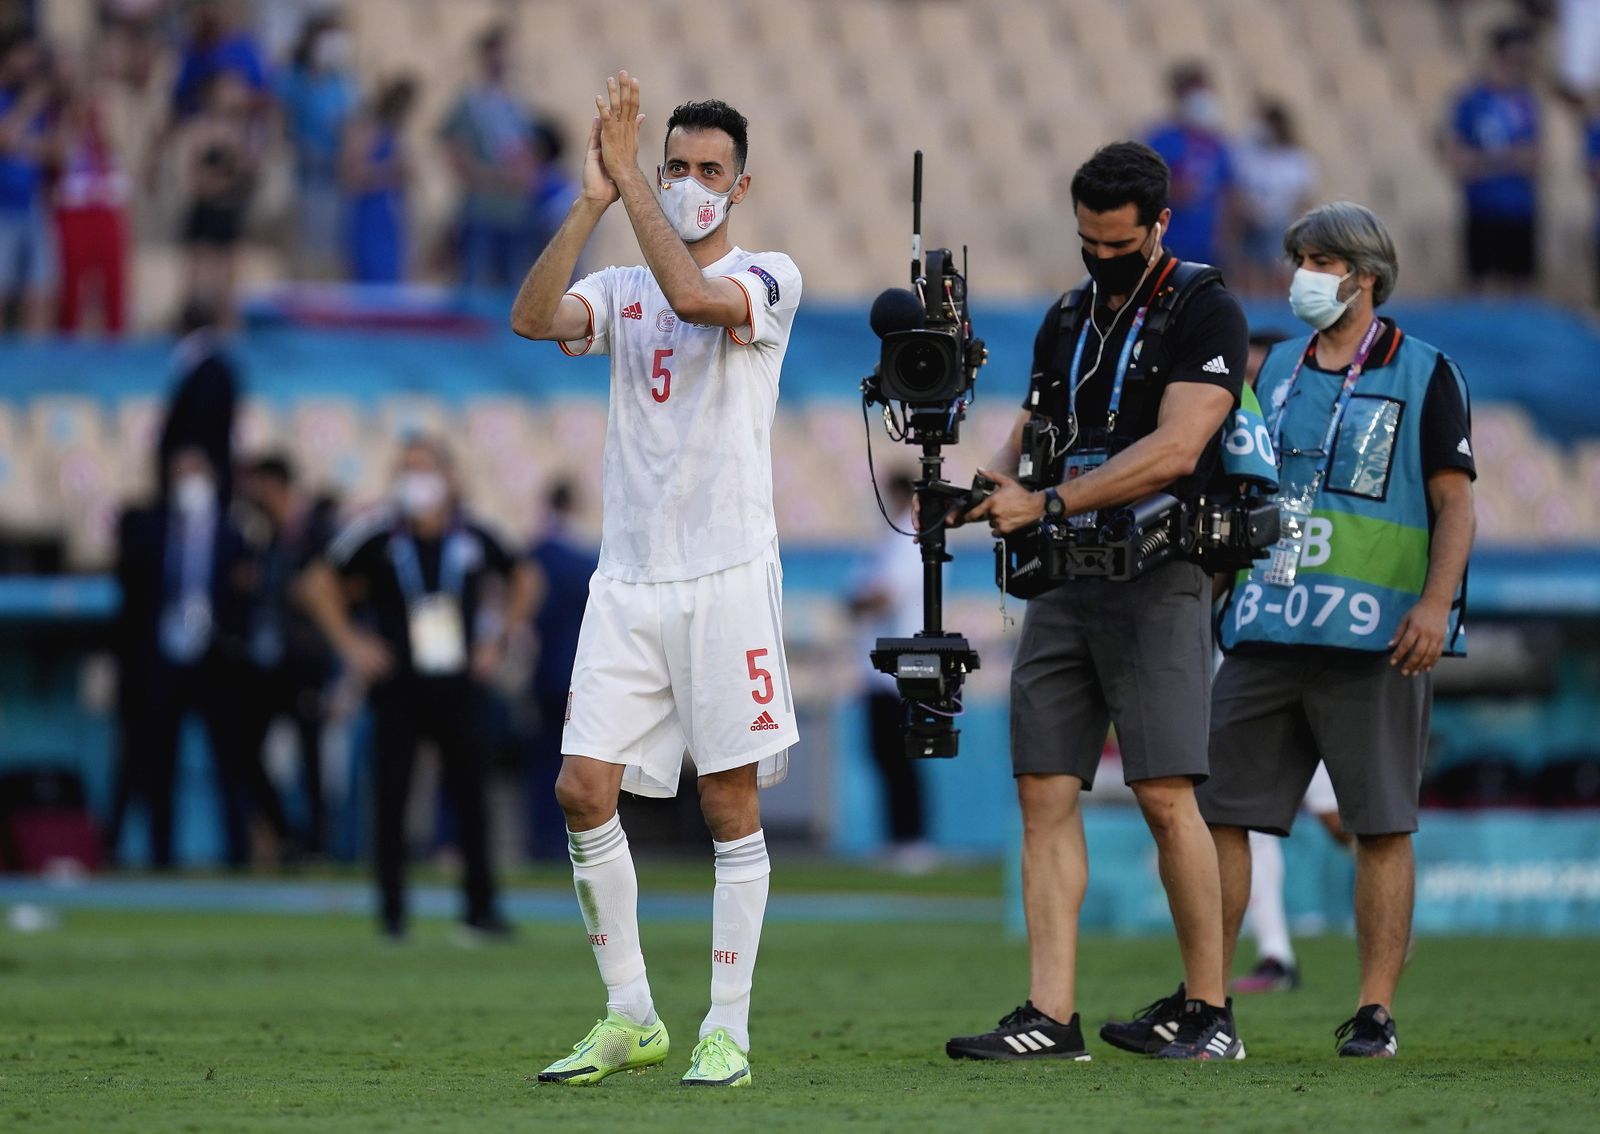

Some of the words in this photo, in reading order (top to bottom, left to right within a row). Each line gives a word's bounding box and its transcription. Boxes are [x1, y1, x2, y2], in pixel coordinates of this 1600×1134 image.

[621, 312, 642, 320] adida
[651, 348, 674, 403] 5
[1221, 414, 1276, 467] 60
[1235, 584, 1381, 636] B-079
[746, 648, 775, 704] 5
[750, 722, 779, 732] adidas
[713, 949, 738, 965] RFEF
